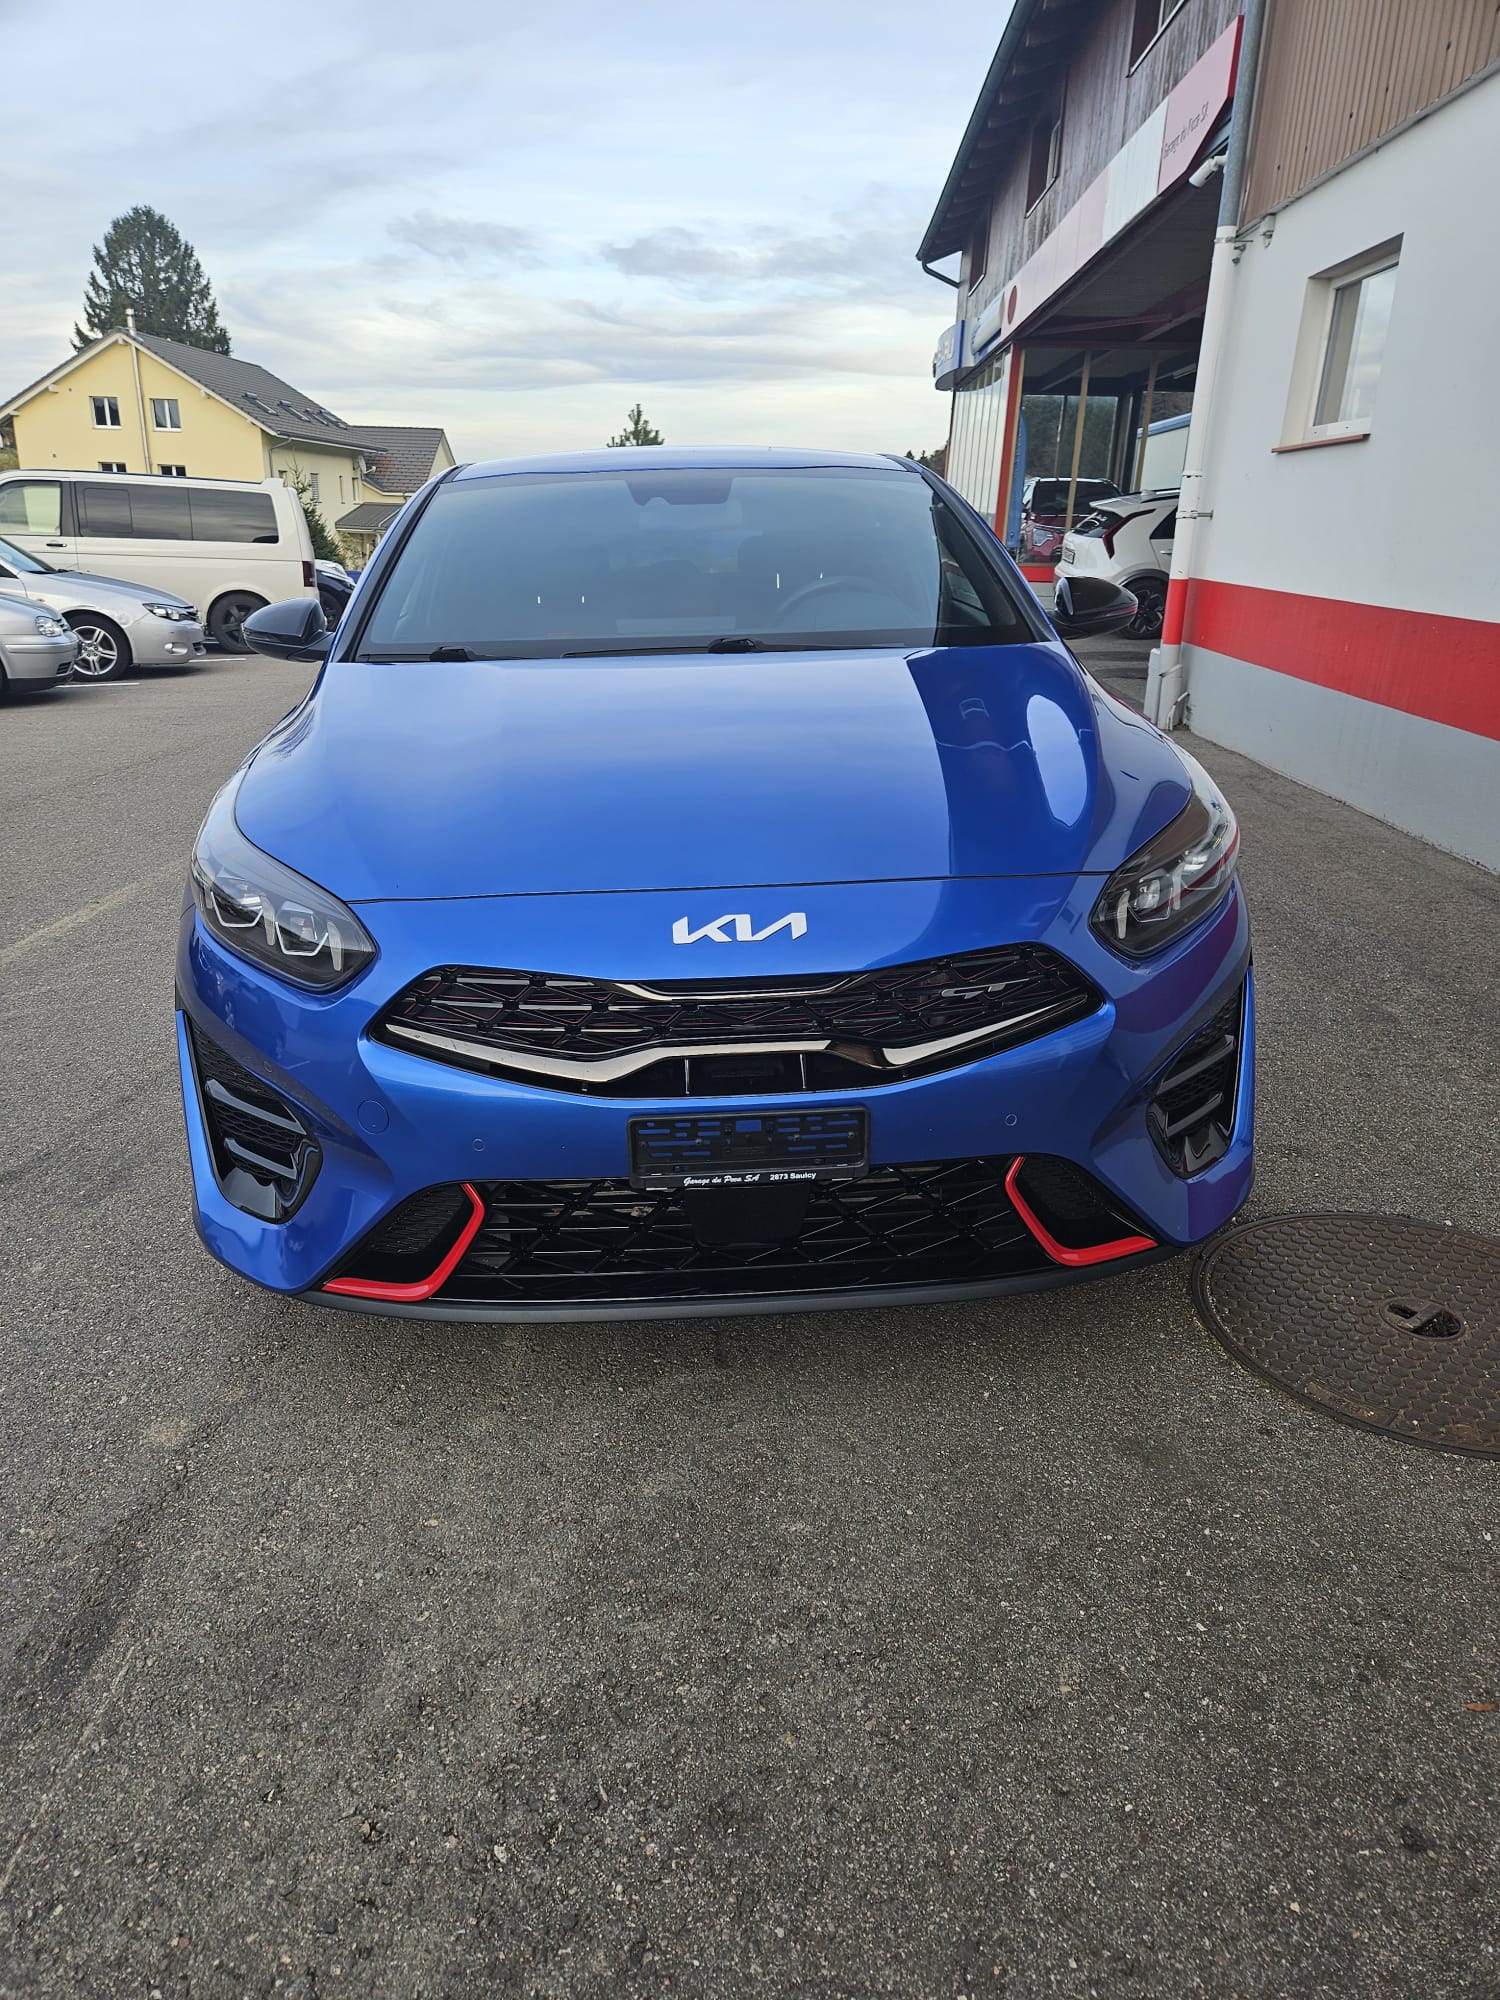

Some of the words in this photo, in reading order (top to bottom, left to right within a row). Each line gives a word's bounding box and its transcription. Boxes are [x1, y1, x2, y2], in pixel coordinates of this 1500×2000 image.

[672, 911, 808, 945] KIA
[941, 982, 1006, 1000] GT
[683, 1176, 711, 1187] Garage
[711, 1176, 722, 1184] du
[743, 1173, 761, 1183] SA
[769, 1173, 789, 1181] 2873
[789, 1171, 817, 1181] Saulcy
